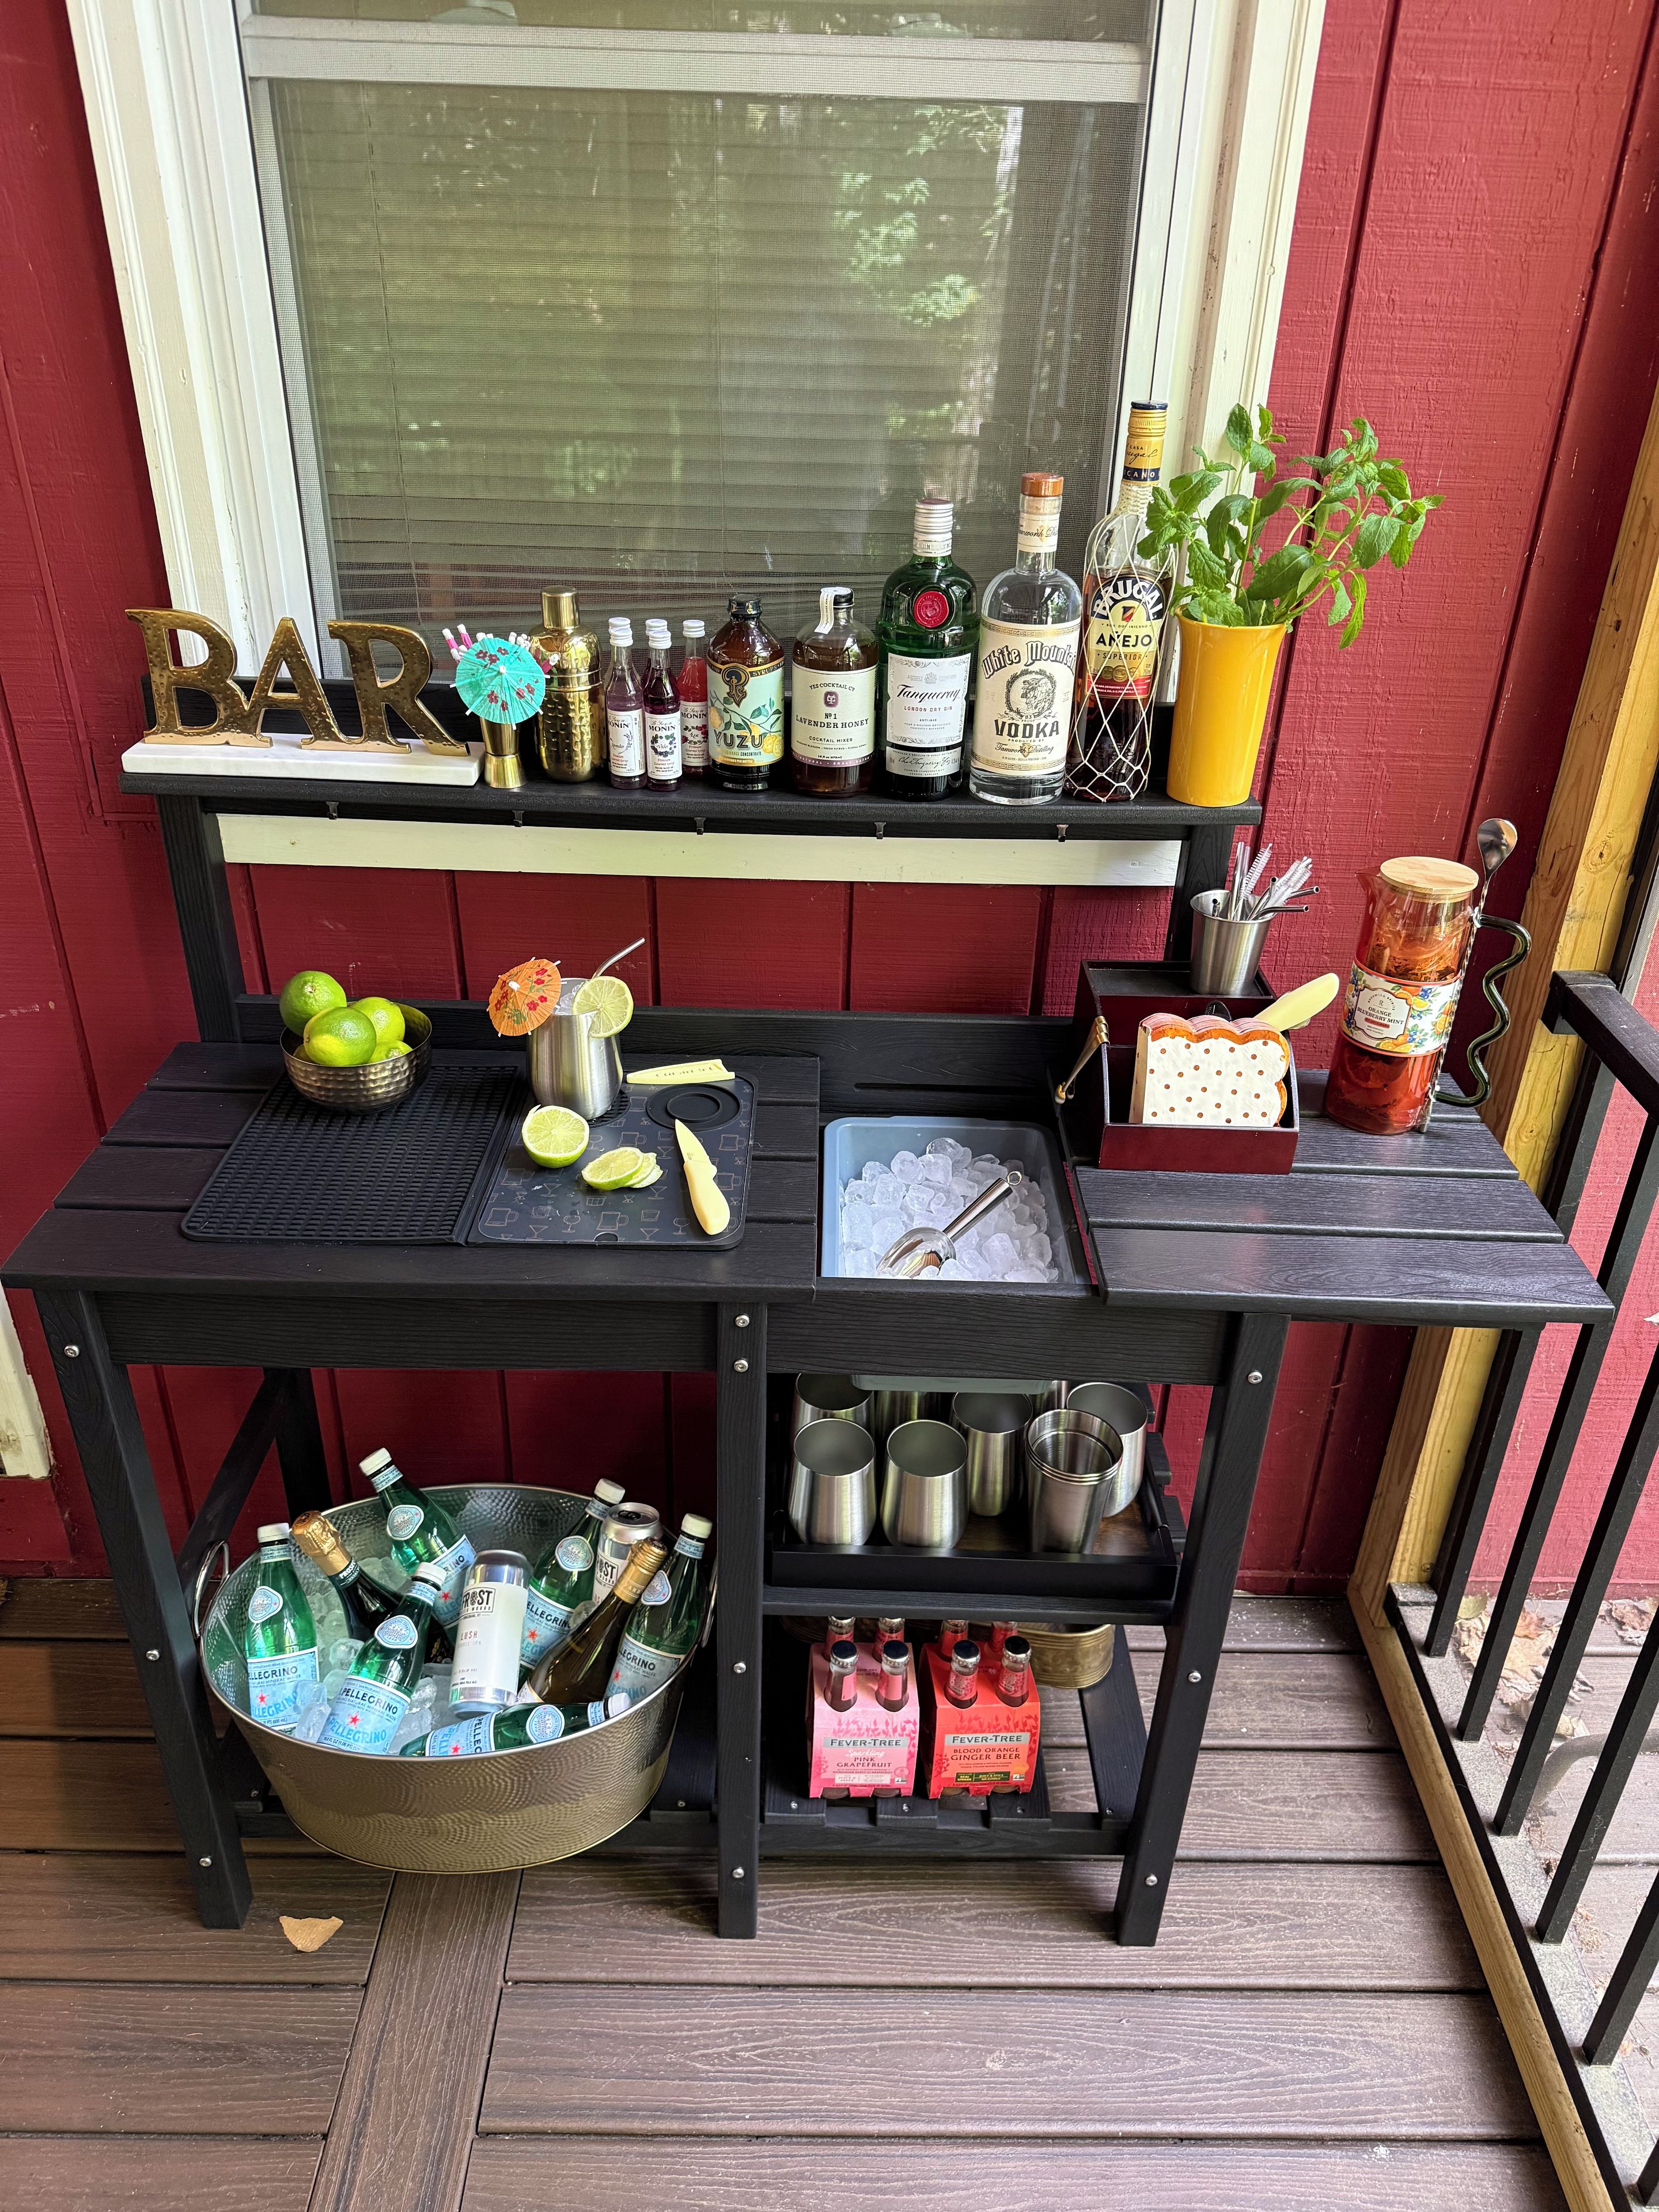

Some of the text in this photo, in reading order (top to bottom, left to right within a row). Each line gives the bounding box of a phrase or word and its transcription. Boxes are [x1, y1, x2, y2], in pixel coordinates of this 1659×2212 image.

[1093, 579, 1163, 619] BRUGAL
[982, 645, 1021, 679] White
[1103, 652, 1142, 661] SUPERIOR
[752, 665, 778, 677] SYRUPS
[125, 608, 470, 756] BAR
[896, 684, 961, 703] Tanqueray
[796, 714, 869, 729] LAVENDER HONEY
[994, 719, 1059, 738] VODKA
[713, 729, 763, 749] YUZU
[995, 742, 1027, 753] Tamworth
[1357, 1006, 1387, 1021] BLUEBERRY
[1368, 1006, 1392, 1017] ORANGE
[460, 1630, 478, 1641] LUSH
[830, 1738, 902, 1747] FEVER-TREE
[952, 1734, 1022, 1744] FEVER-TREE
[844, 1749, 885, 1758] Sparkling
